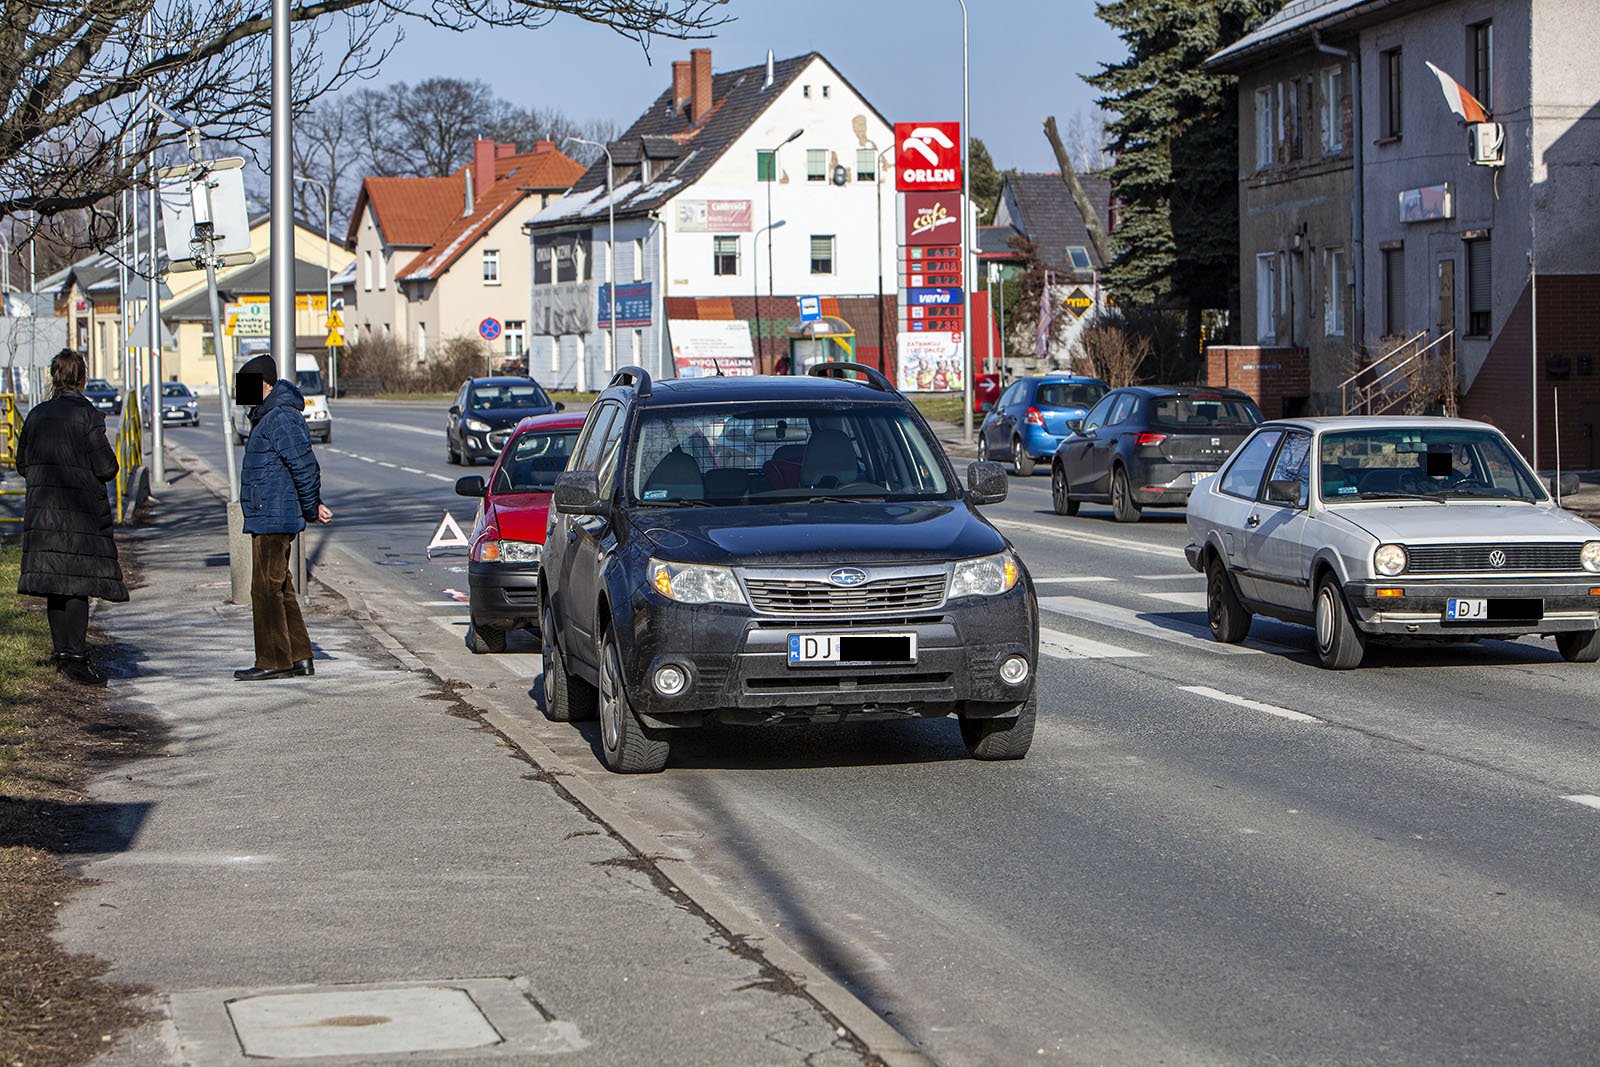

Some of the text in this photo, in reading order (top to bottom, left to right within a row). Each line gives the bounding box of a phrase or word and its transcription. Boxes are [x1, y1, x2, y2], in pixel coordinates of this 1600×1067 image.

[903, 169, 955, 183] ORLEN
[919, 294, 950, 303] verva
[1458, 601, 1482, 617] DJ
[805, 637, 831, 659] DJ
